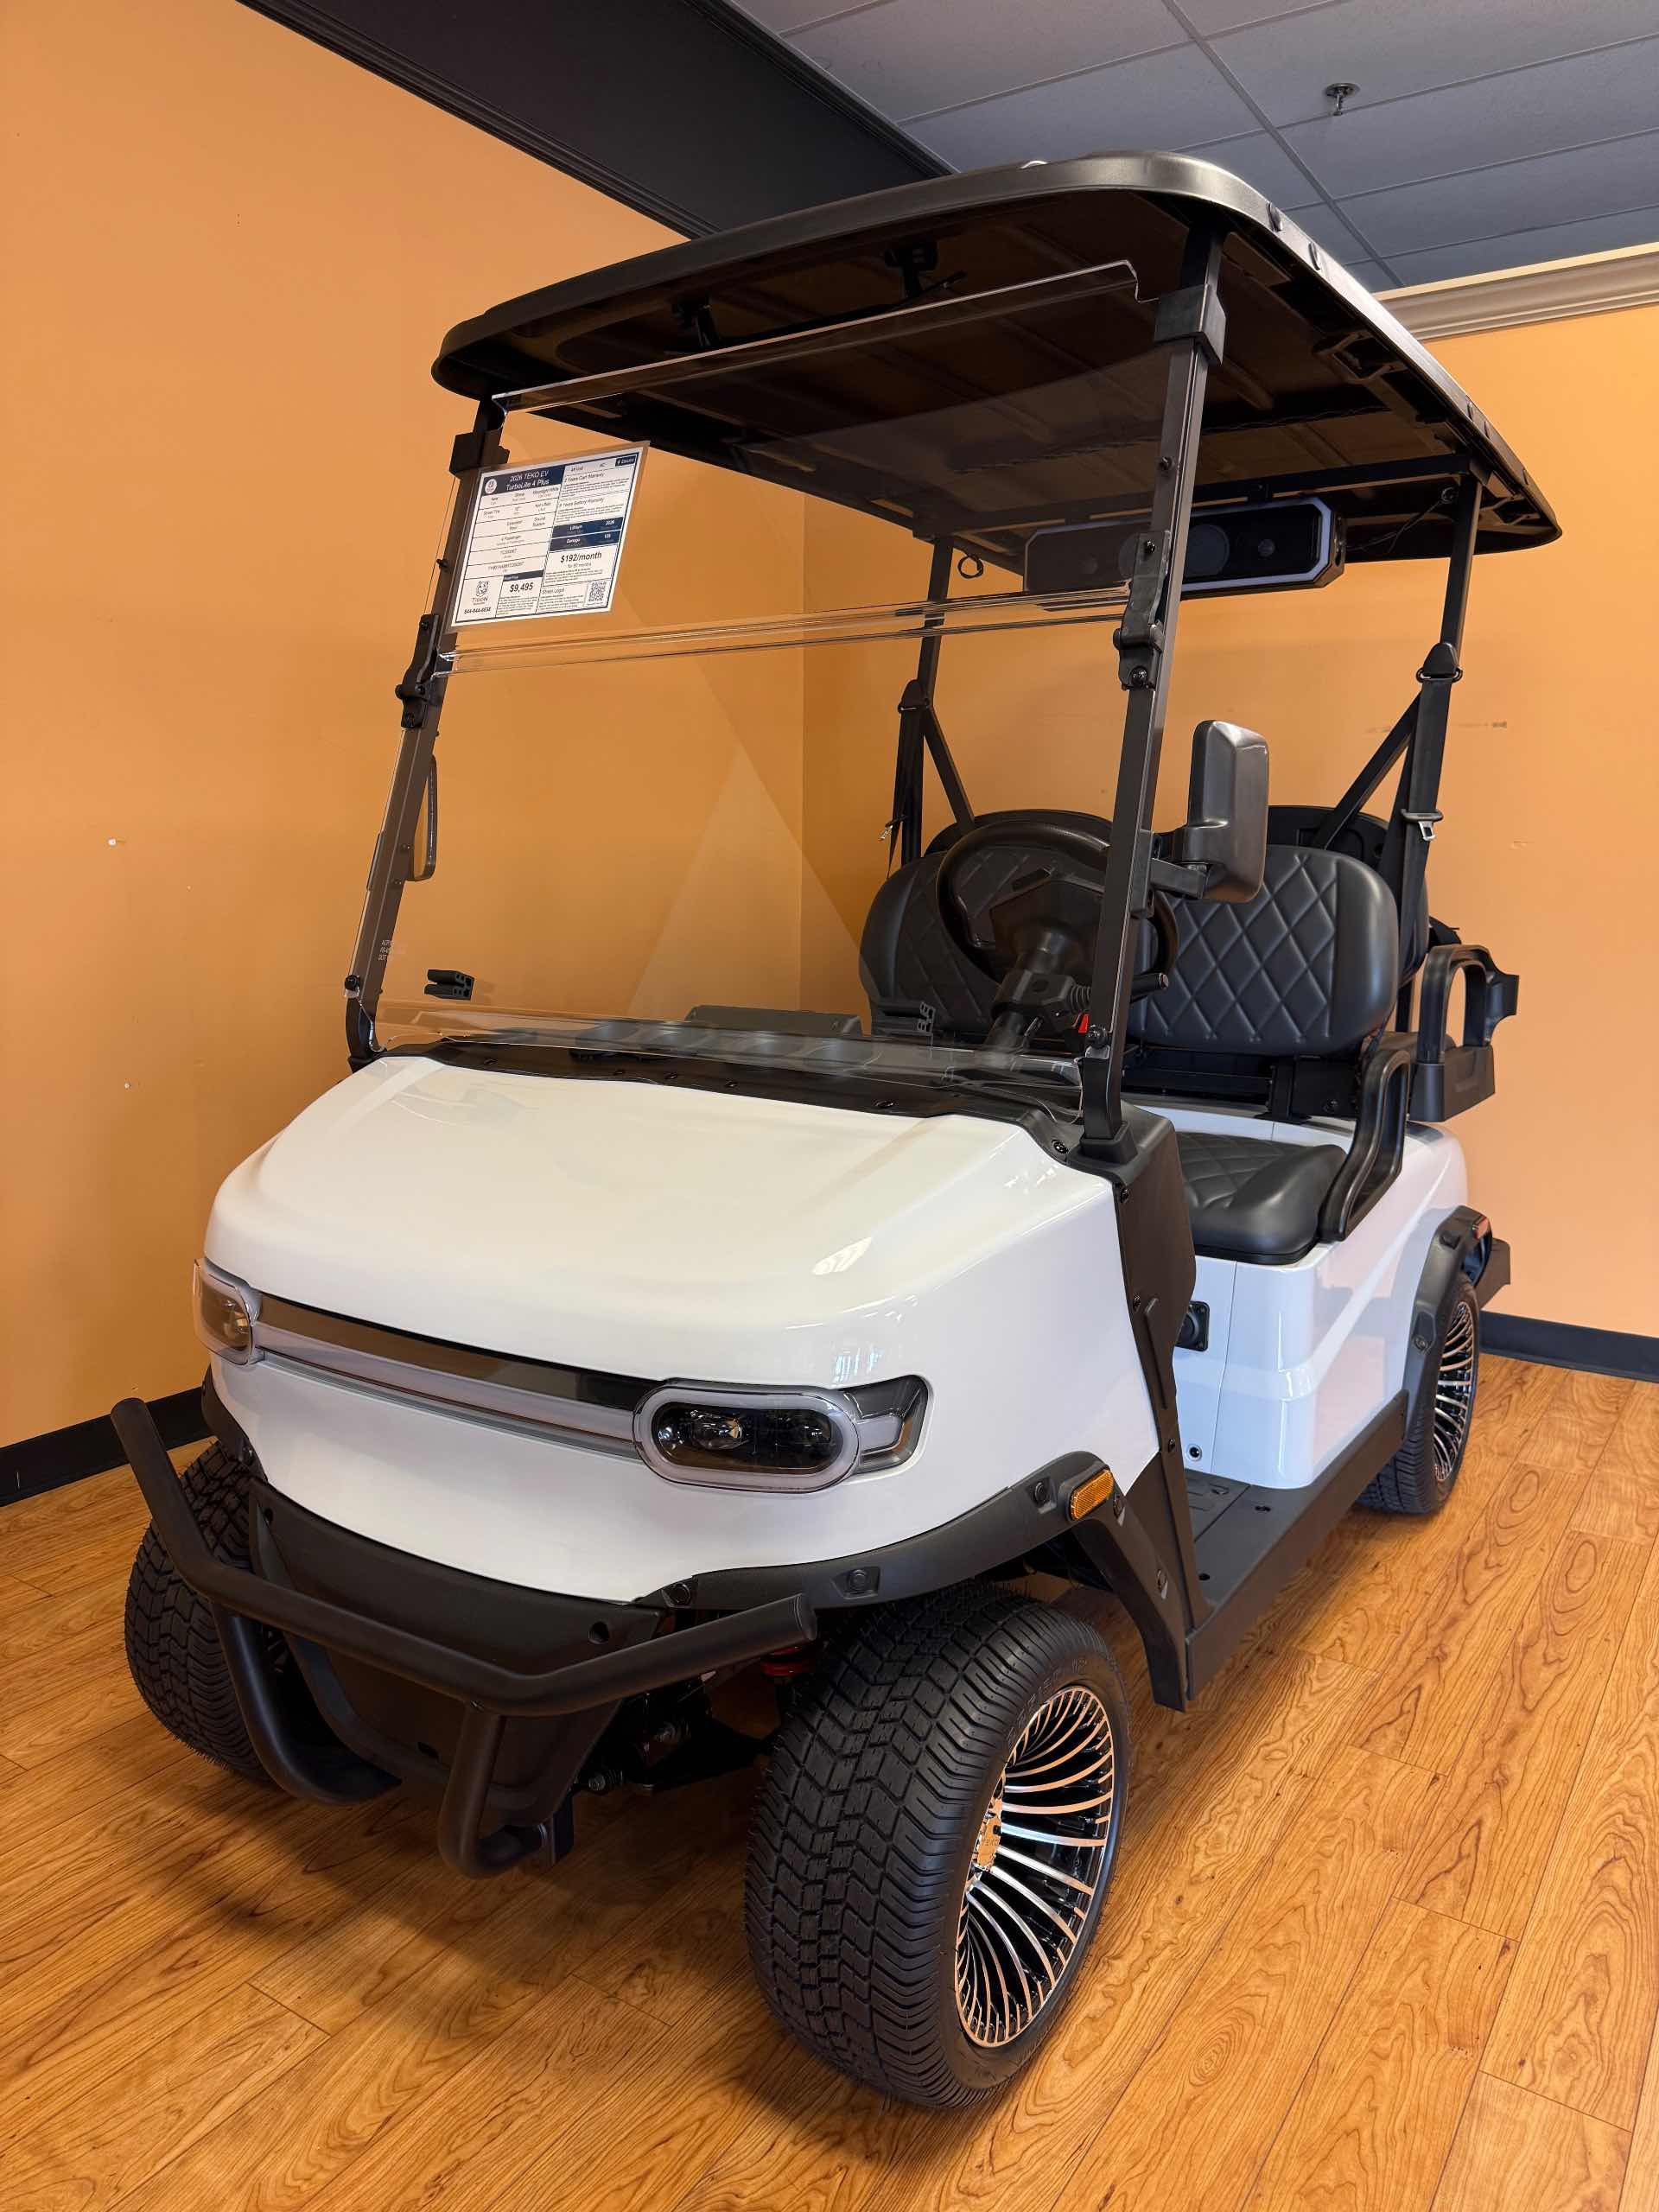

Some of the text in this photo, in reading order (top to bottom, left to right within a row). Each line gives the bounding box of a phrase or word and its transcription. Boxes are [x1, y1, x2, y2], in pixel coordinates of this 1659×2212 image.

[540, 469, 550, 478] EV
[560, 551, 602, 563] $192/month
[510, 582, 534, 593] $9,495
